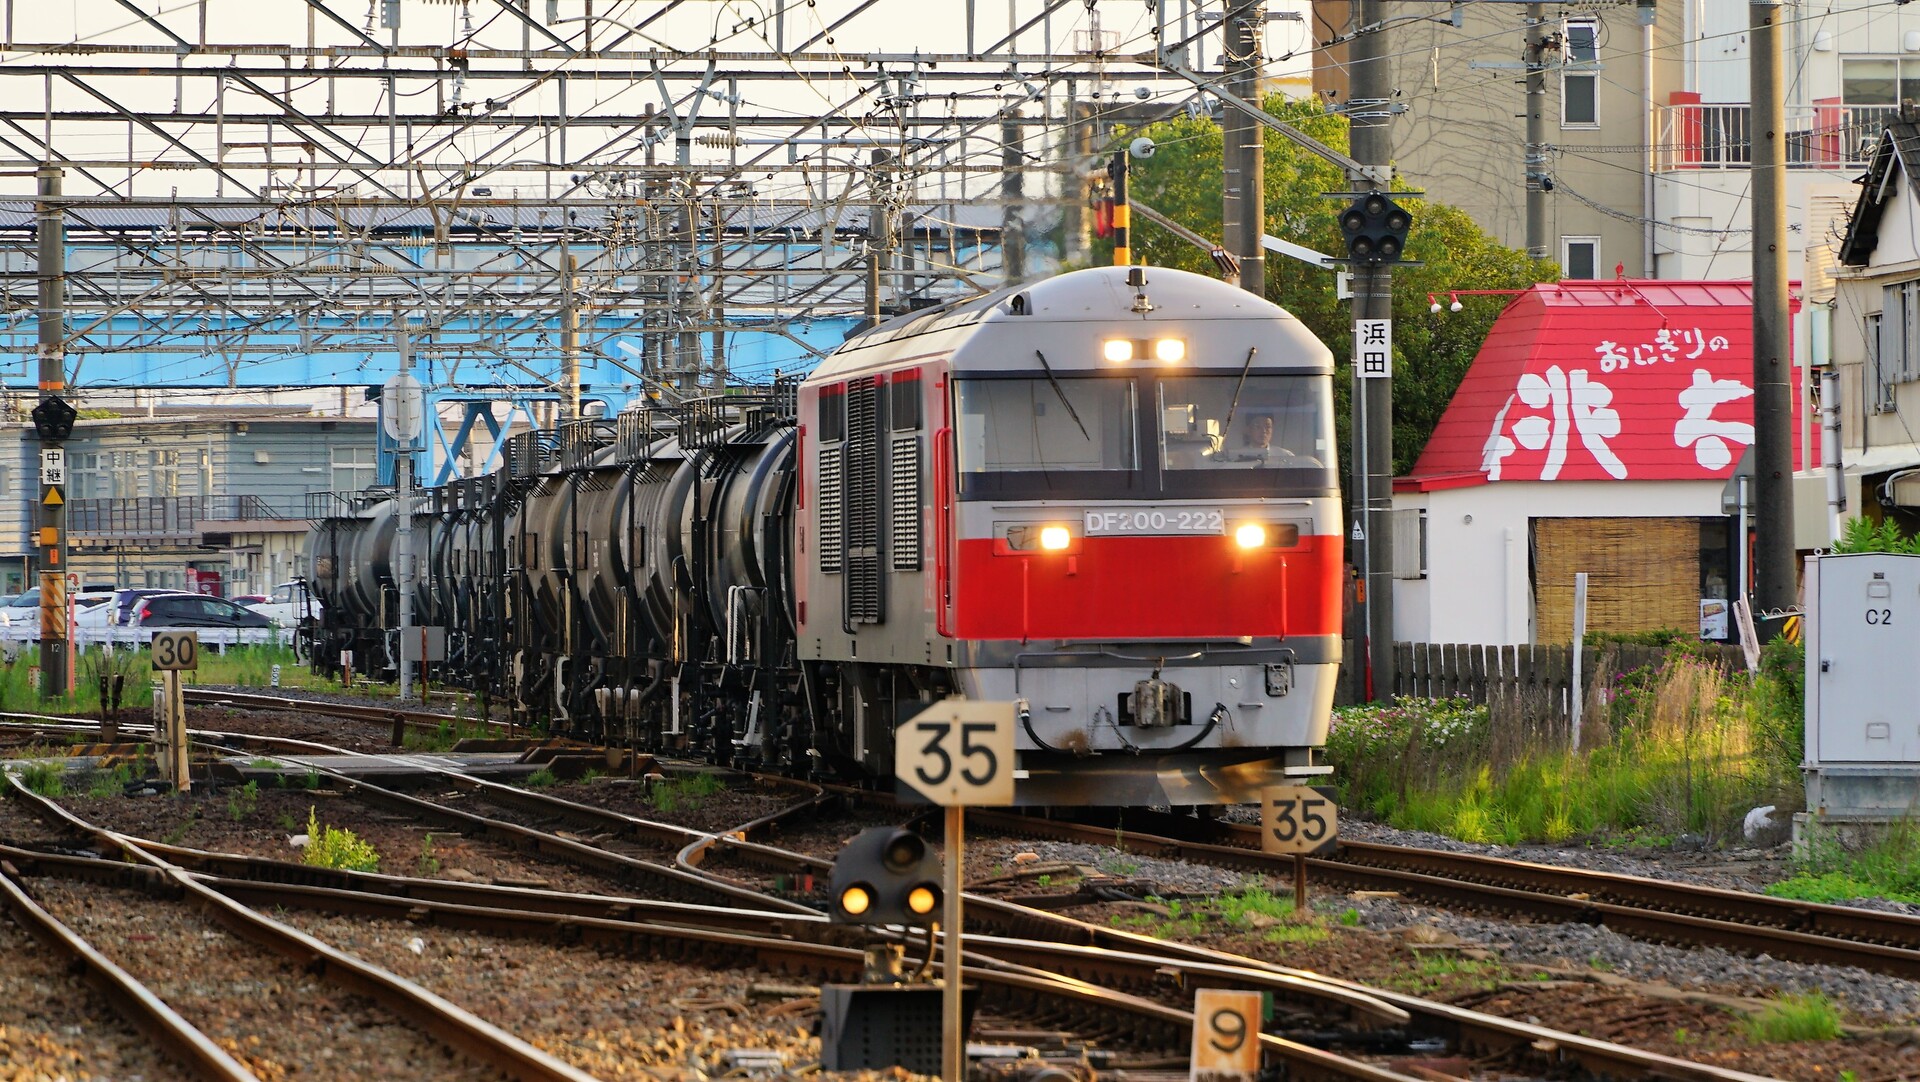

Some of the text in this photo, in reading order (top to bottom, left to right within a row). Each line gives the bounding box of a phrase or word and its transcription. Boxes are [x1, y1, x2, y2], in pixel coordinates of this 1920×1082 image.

[1363, 323, 1385, 373] 浜田
[1595, 327, 1729, 373] おにぎりの
[46, 451, 61, 482] 中継
[1087, 511, 1222, 531] DF200-222
[1866, 609, 1892, 625] C2
[159, 636, 194, 666] 30
[915, 723, 998, 786] 35
[1272, 799, 1327, 842] 35
[1209, 1008, 1247, 1054] 9
